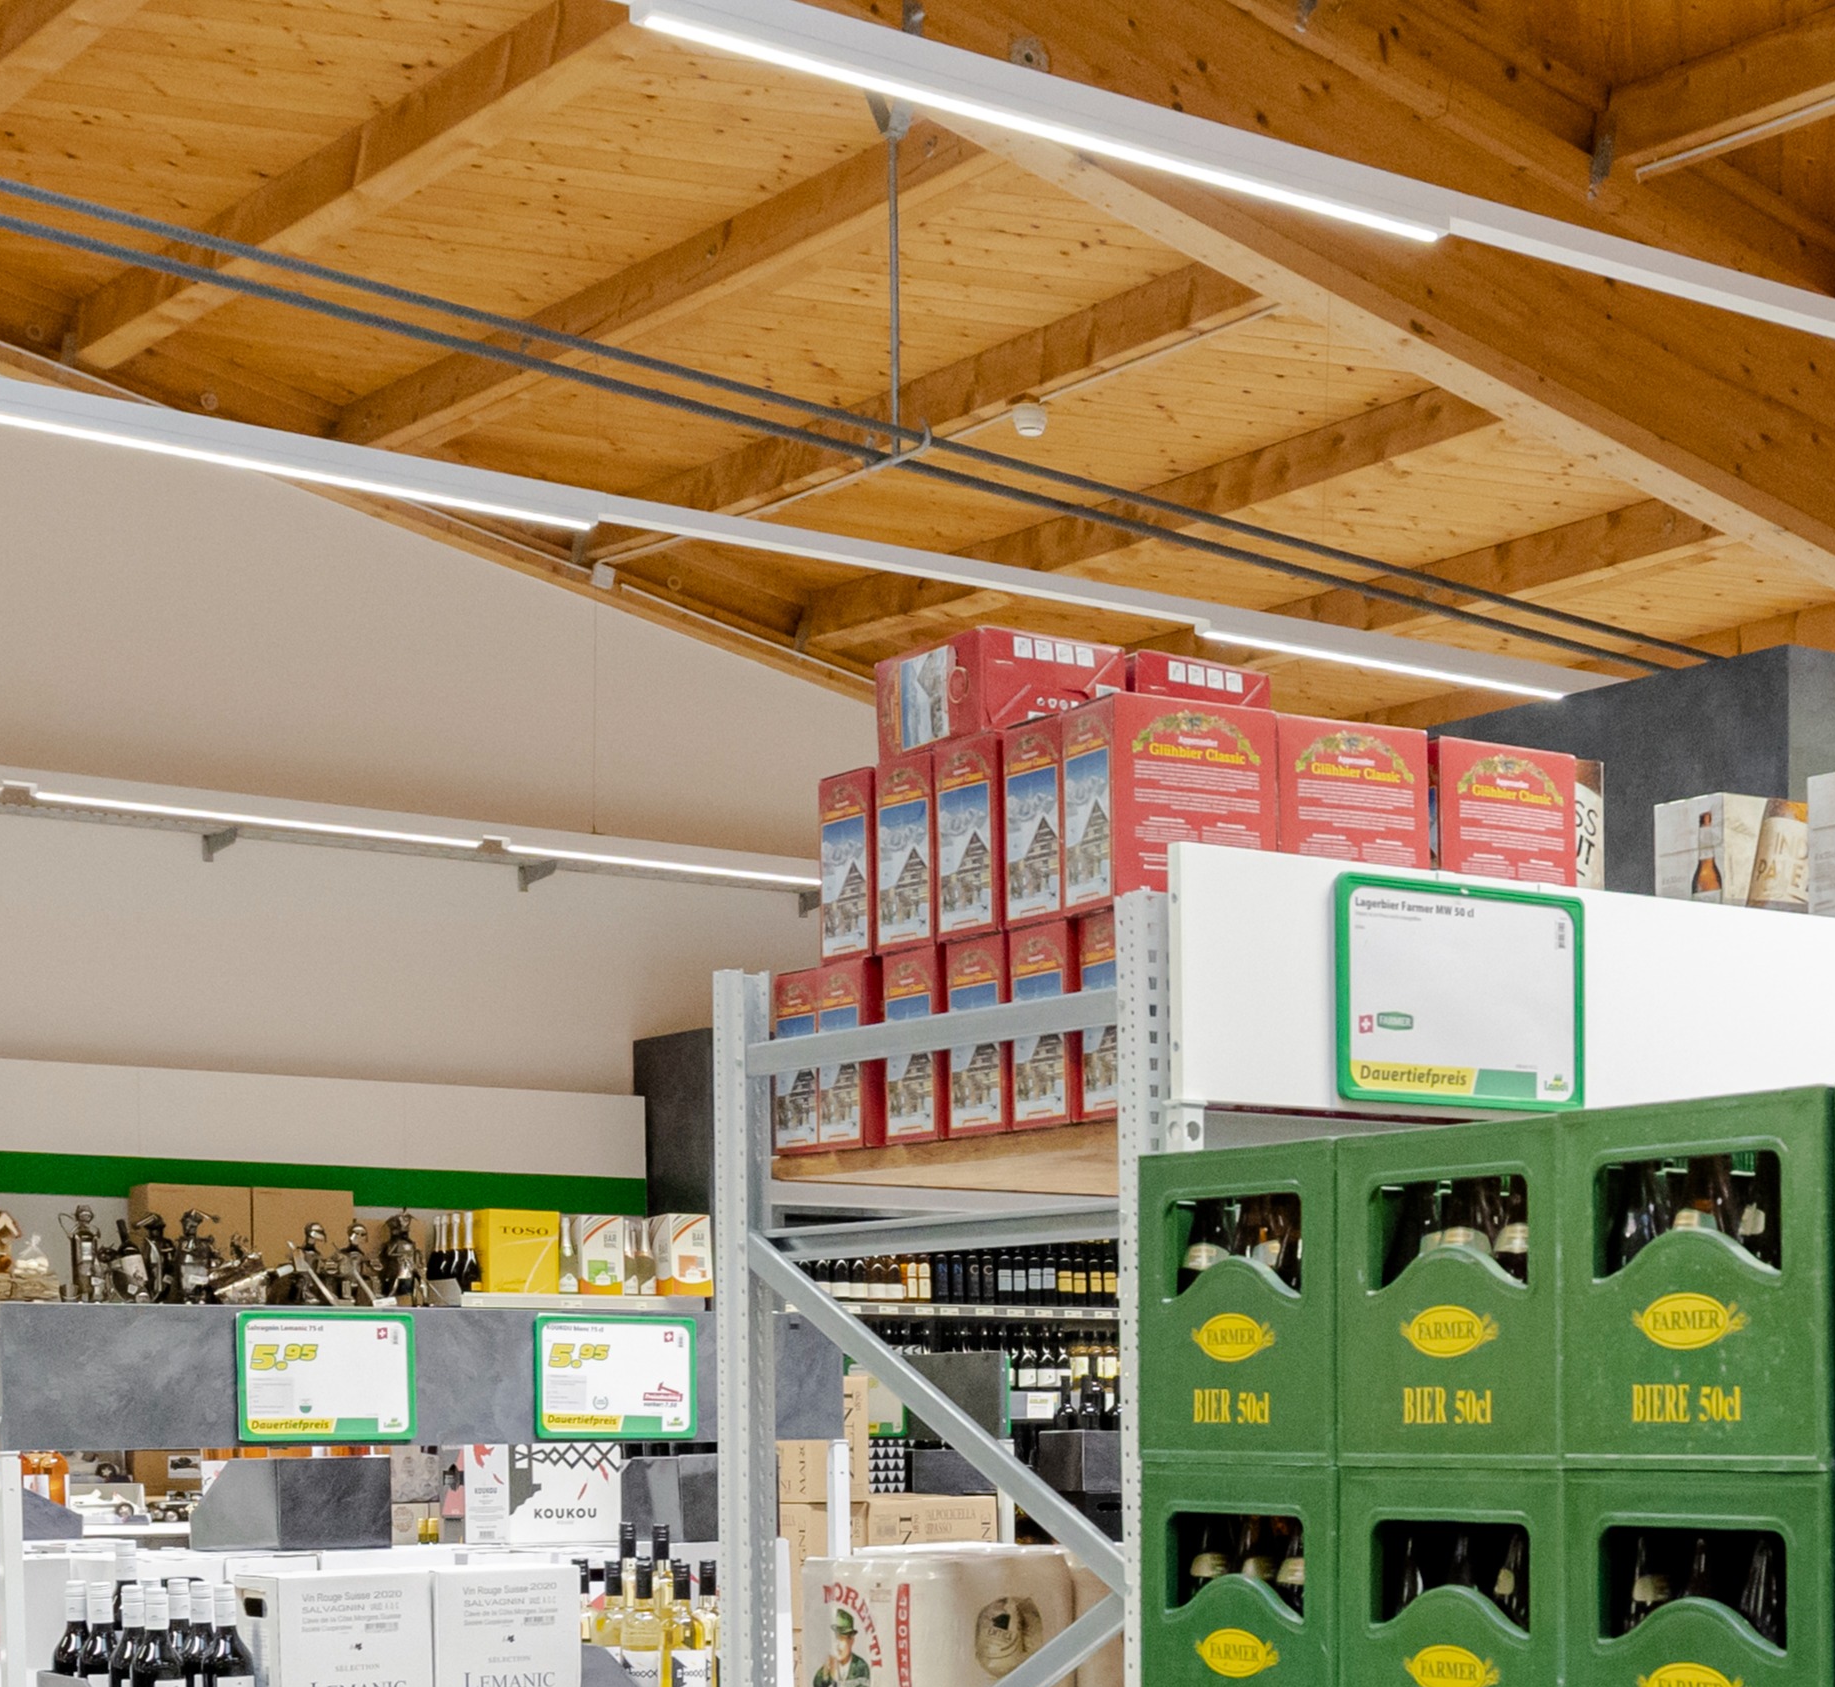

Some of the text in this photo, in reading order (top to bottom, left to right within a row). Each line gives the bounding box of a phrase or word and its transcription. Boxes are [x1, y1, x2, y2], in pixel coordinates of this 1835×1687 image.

[1149, 743, 1246, 765] Glühbier Classic
[1311, 762, 1401, 783] Glühbier Classic
[1472, 784, 1552, 805] Glühbier Classic
[1355, 896, 1474, 917] Lagerbier Farmer MW 50 cl
[1378, 1015, 1412, 1027] FARMER
[1360, 1065, 1466, 1087] Dauertiefpreis
[499, 1225, 549, 1235] TOSO
[1648, 1306, 1725, 1335] FARMER
[1203, 1324, 1259, 1349] FARMER
[250, 1343, 319, 1371] 5.95
[548, 1343, 611, 1369] 5.95
[1193, 1388, 1271, 1424] BIER 50cl
[1631, 1383, 1742, 1423] BIERE 50cl
[251, 1419, 329, 1431] Dauertiefpreis
[547, 1414, 617, 1426] Dauertiefpreis
[534, 1508, 597, 1519] KOUKOU
[373, 1590, 402, 1599] 2020
[477, 1585, 502, 1595] Rouge
[529, 1582, 557, 1591] 2020
[302, 1603, 366, 1614] SALVAGNIN
[823, 1581, 883, 1669] MORETTI
[1416, 1655, 1482, 1686] FARMER
